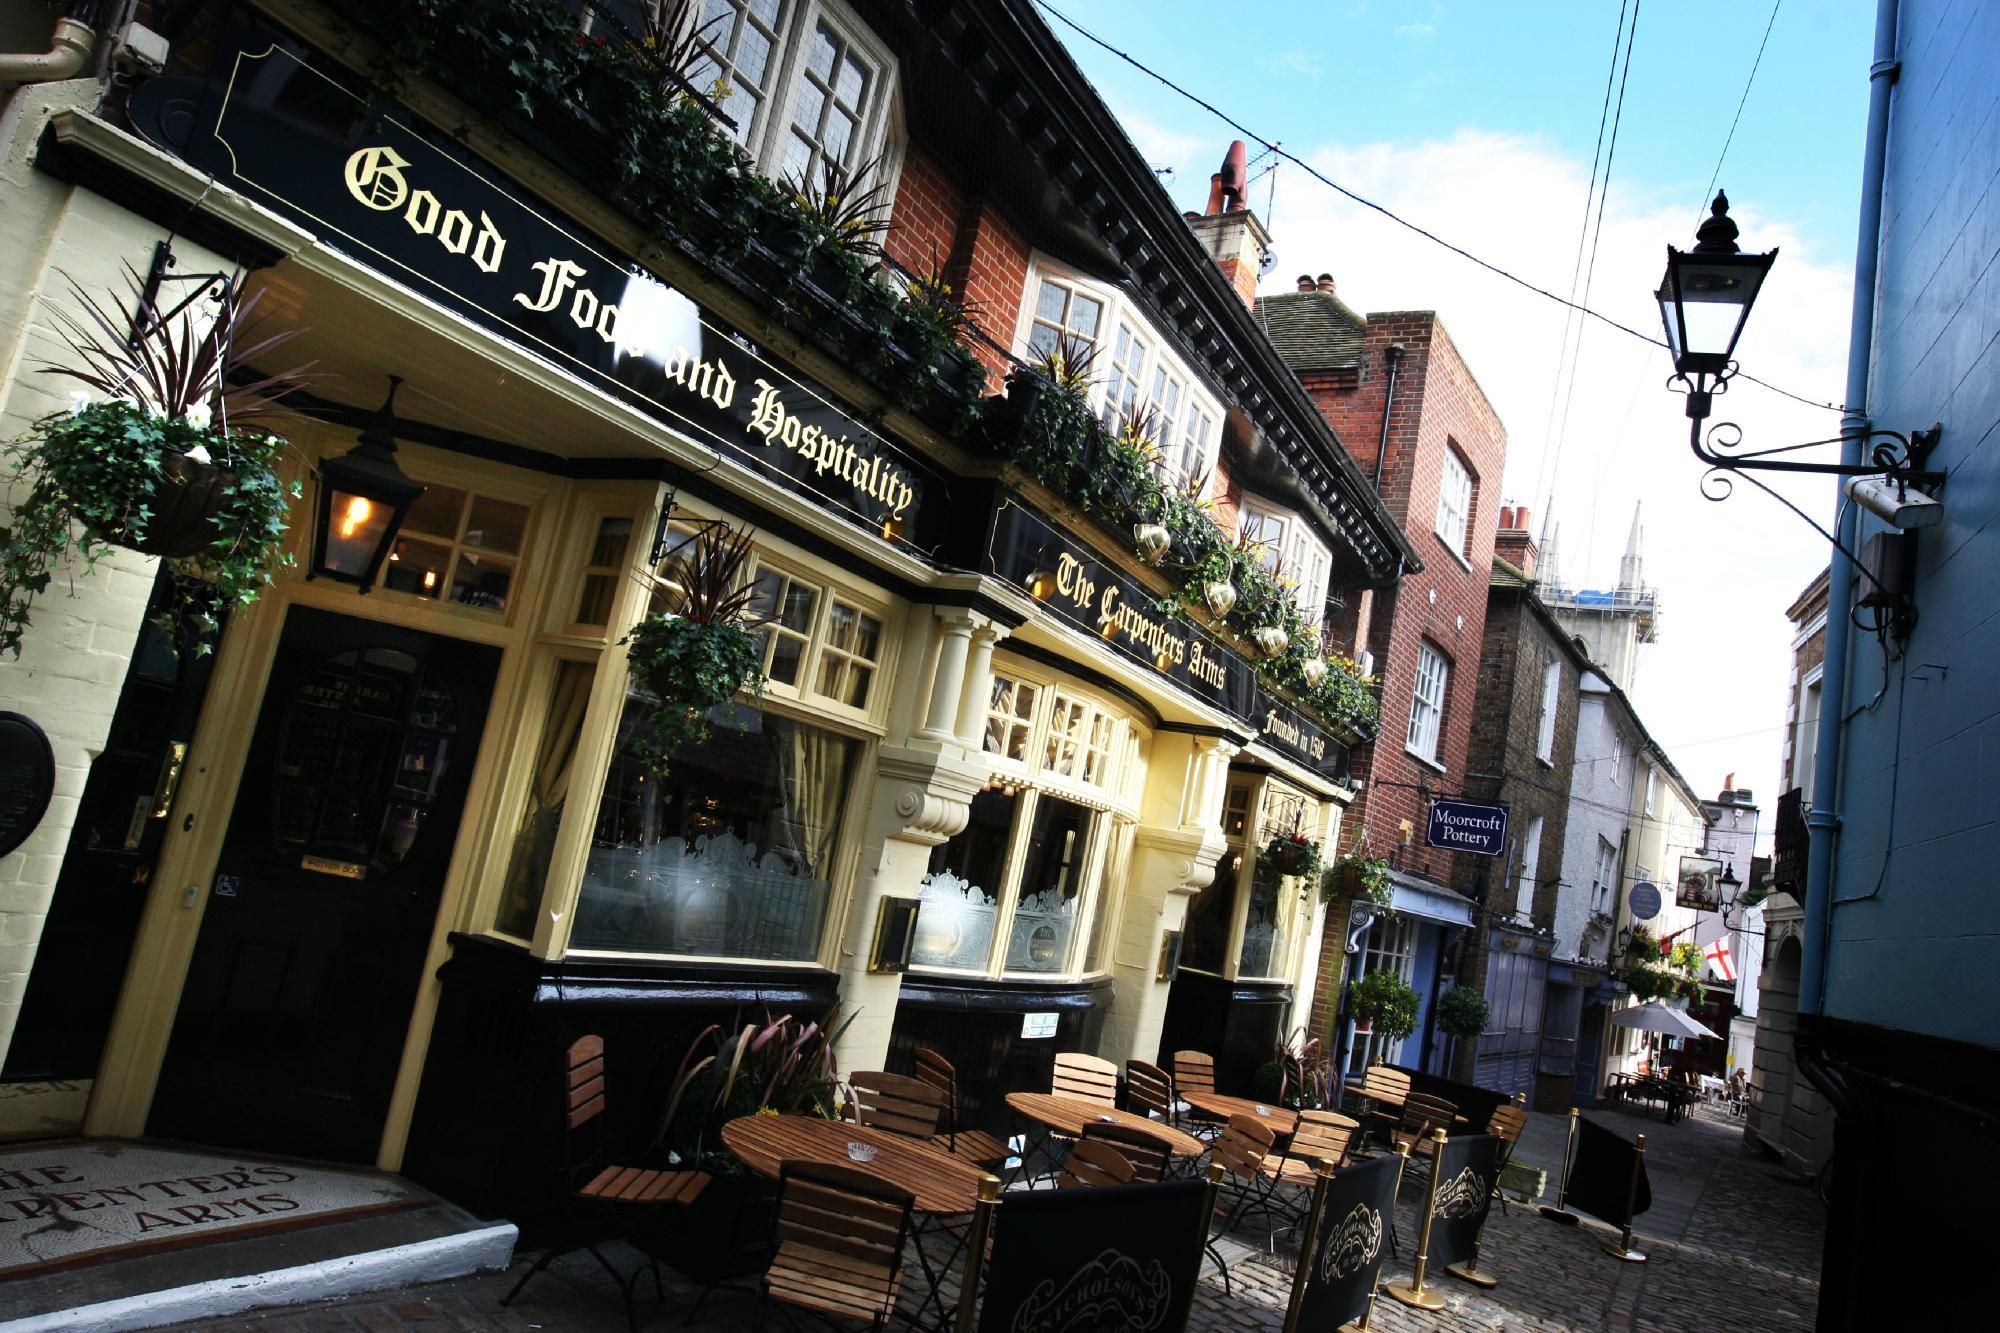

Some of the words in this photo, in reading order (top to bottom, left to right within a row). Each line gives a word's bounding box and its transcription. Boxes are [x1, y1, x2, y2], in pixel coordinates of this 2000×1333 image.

[344, 146, 508, 273] Good
[664, 344, 736, 409] and
[746, 378, 913, 521] Hospitality
[1056, 553, 1095, 609] The
[1187, 641, 1227, 691] Arms
[1262, 708, 1300, 747] Founded
[1299, 728, 1309, 753] in
[1434, 808, 1501, 831] Moorcroft
[1442, 825, 1491, 848] Pottery
[135, 1193, 301, 1233] ARMS
